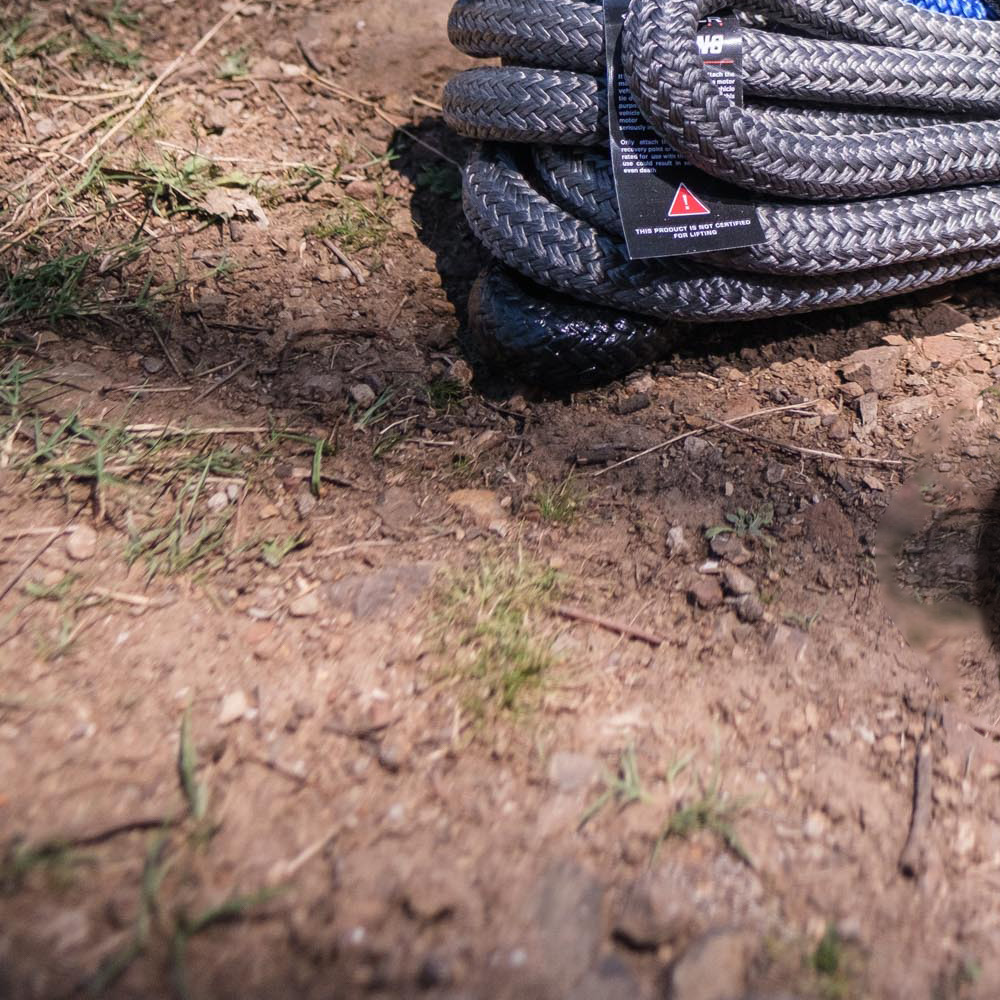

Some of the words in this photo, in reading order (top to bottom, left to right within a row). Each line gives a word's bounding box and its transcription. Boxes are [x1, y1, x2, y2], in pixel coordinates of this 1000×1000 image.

[654, 225, 687, 233] PRODUCT
[715, 219, 751, 228] CERTIFIED
[689, 229, 718, 238] LIFTING
